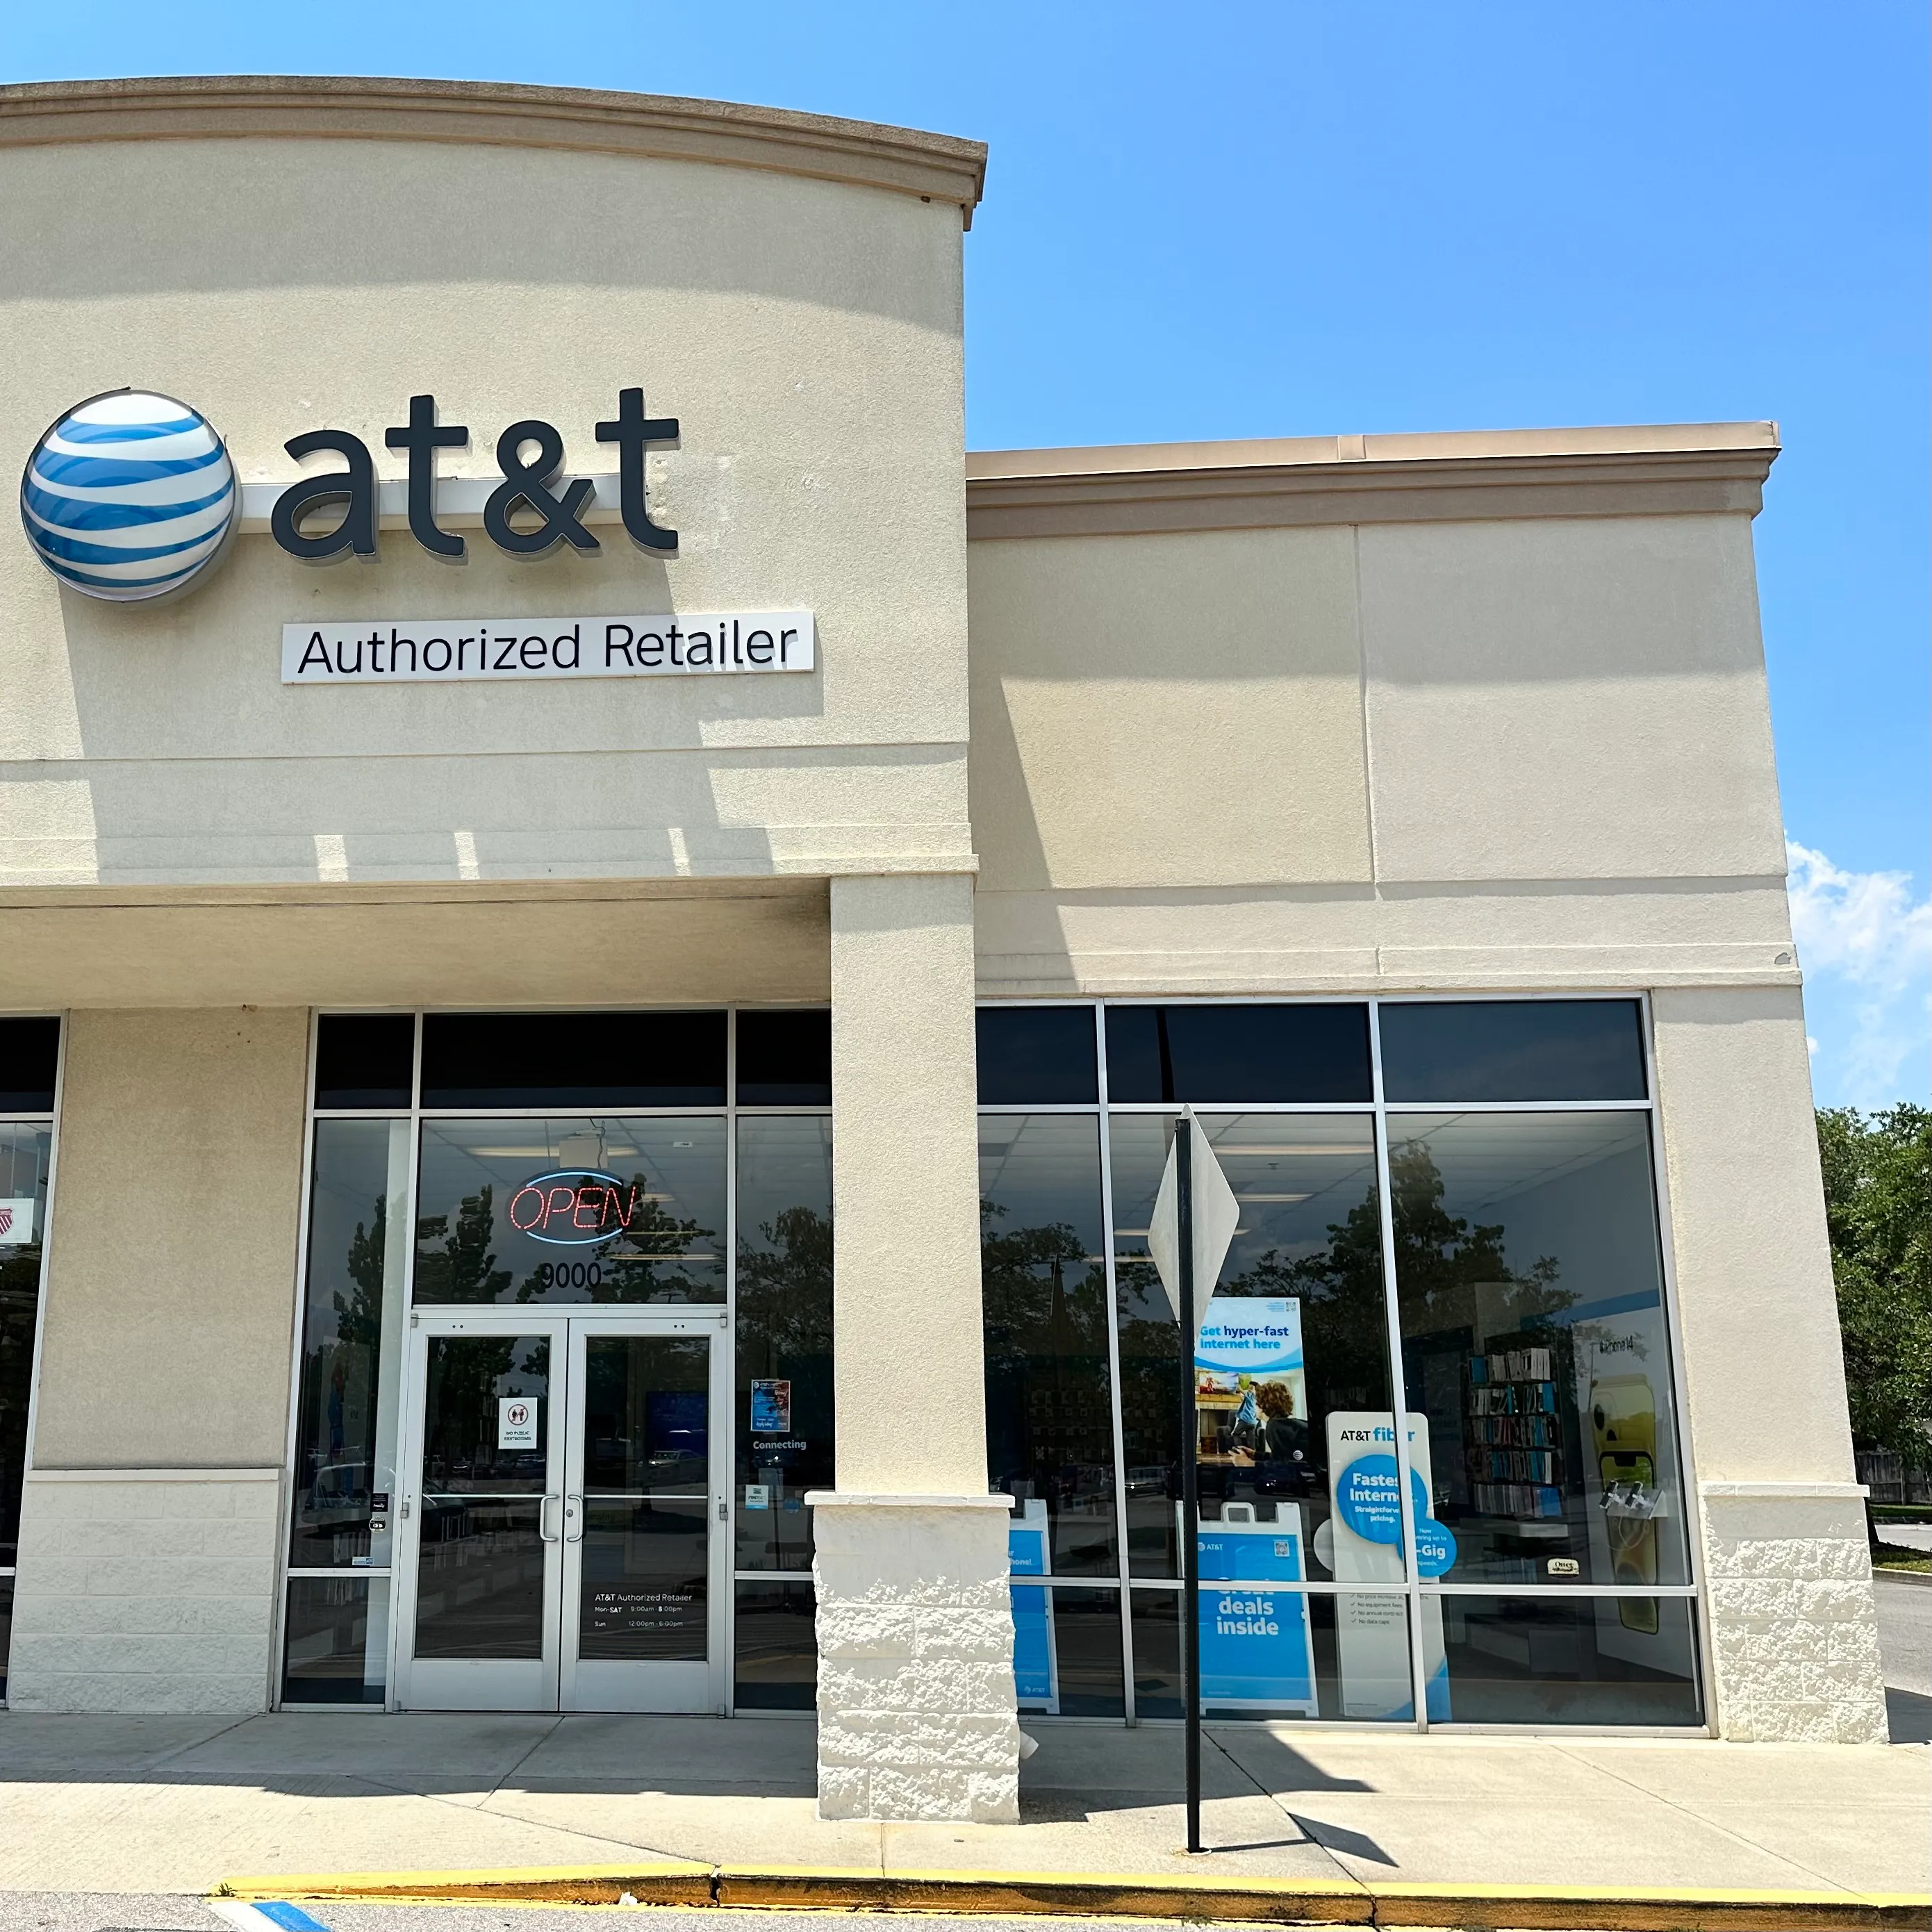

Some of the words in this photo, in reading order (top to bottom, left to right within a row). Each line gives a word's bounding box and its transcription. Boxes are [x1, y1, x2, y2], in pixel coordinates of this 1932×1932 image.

[297, 624, 580, 675] Authorized
[605, 620, 798, 668] Retailer
[511, 1185, 636, 1230] OPEN
[540, 1262, 602, 1289] 9000
[1200, 1326, 1221, 1336] Get
[1223, 1326, 1289, 1339] hyper-fast
[1200, 1338, 1250, 1349] internet
[1253, 1338, 1281, 1349] here
[1340, 1430, 1371, 1442] AT&T
[1373, 1427, 1415, 1442] fibr
[753, 1439, 807, 1450] Connecting
[1350, 1488, 1399, 1502] Intern
[1355, 1505, 1399, 1514] Straightforw
[1417, 1544, 1446, 1560] -Gig
[1219, 1596, 1274, 1615] deals
[1216, 1616, 1279, 1635] inside
